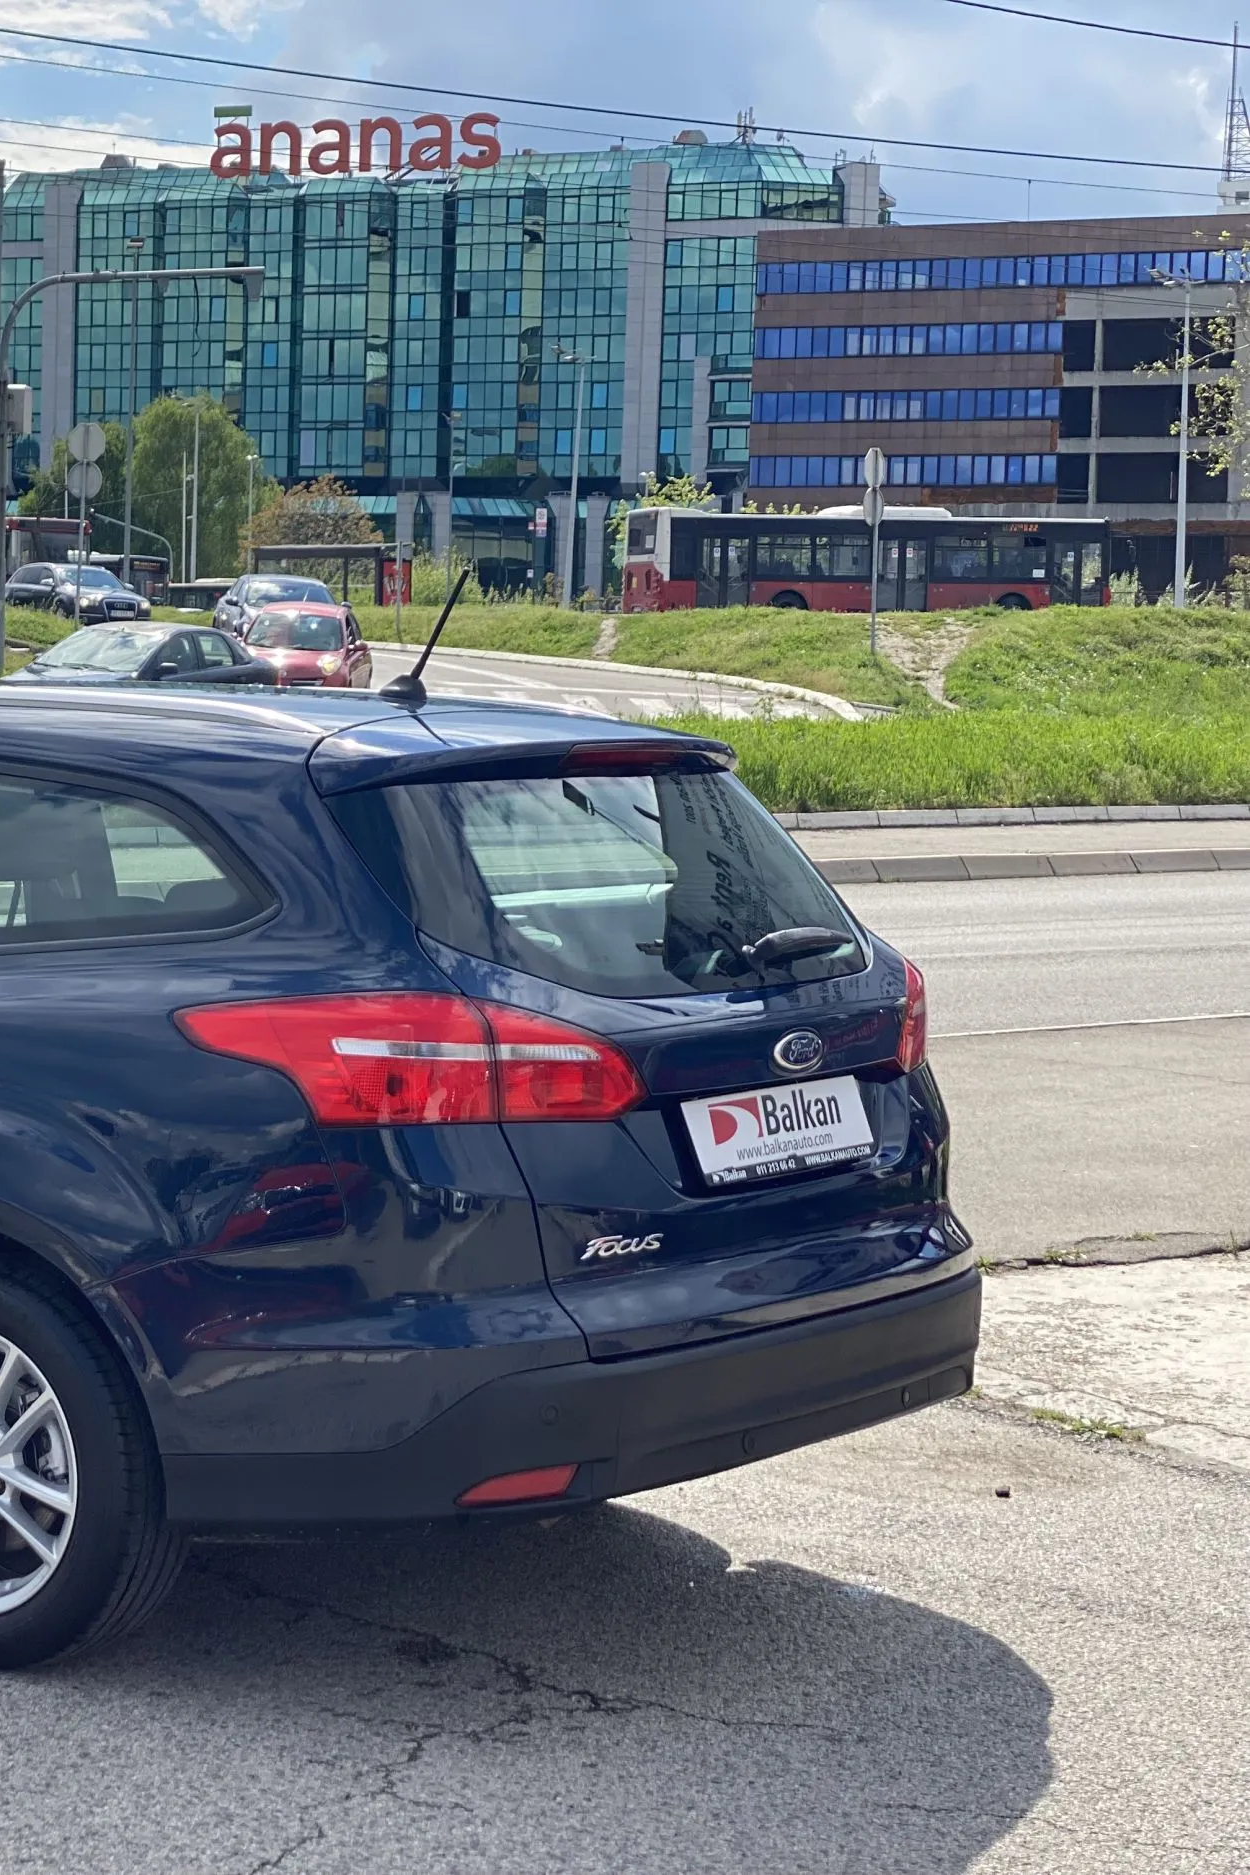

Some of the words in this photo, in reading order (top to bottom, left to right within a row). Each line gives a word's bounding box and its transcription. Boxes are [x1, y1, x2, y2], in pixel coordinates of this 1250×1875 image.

[789, 1038, 819, 1061] Ford
[761, 1089, 843, 1136] Balkan
[736, 1131, 834, 1161] www.balkanauto.com
[756, 1163, 768, 1175] 011
[803, 1145, 871, 1166] WWW.BALKANAUTO.COM
